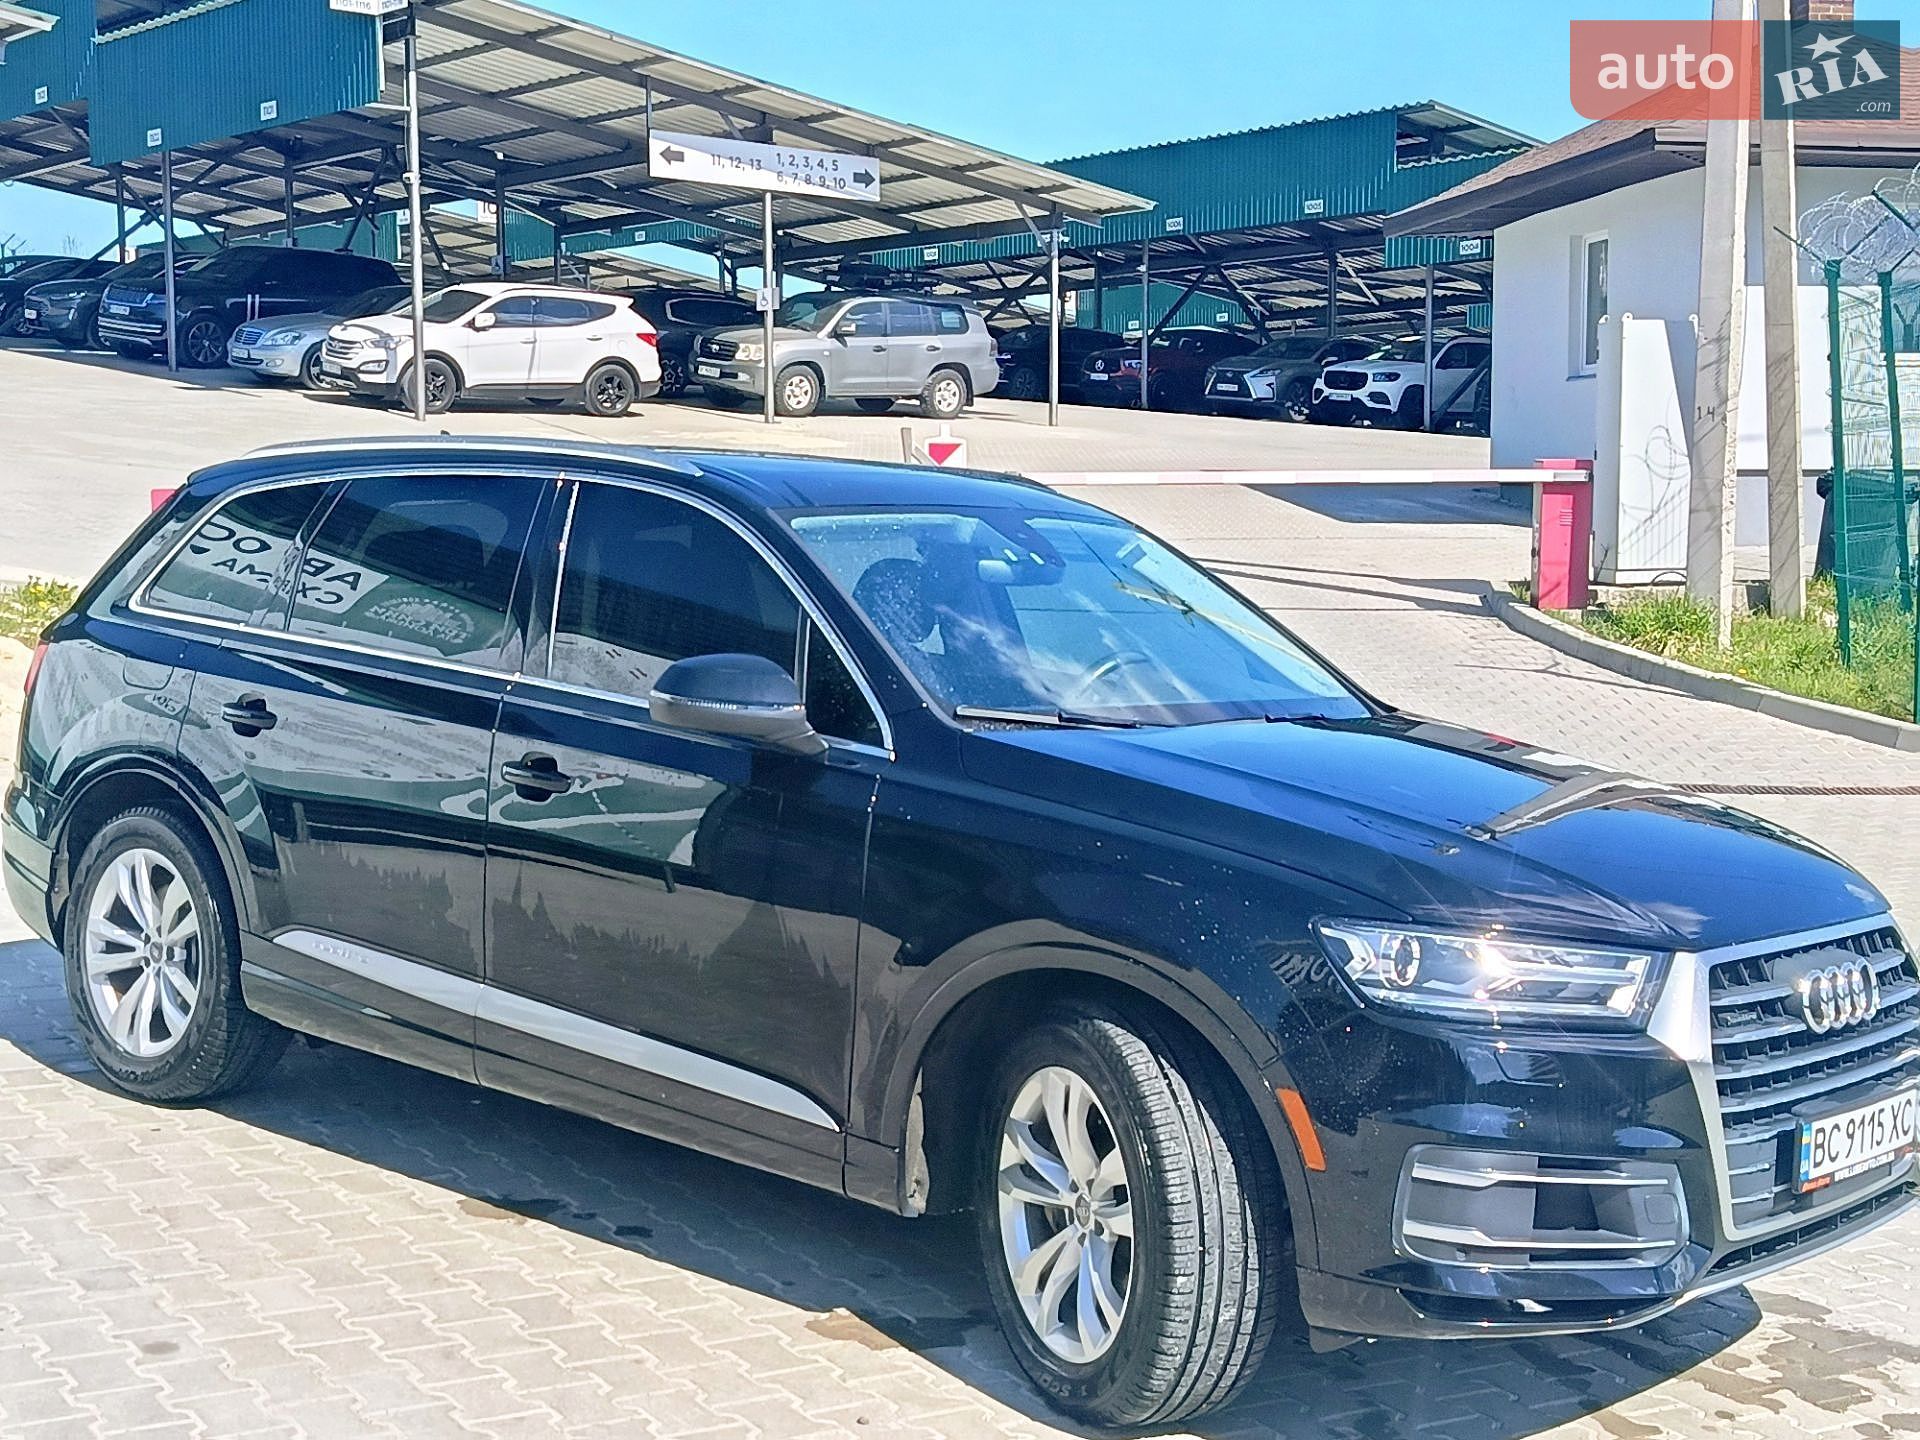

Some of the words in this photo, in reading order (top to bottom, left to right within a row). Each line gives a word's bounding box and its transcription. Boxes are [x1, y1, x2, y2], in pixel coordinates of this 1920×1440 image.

[711, 153, 725, 169] 11,
[729, 156, 745, 171] 12,
[749, 158, 762, 171] 13
[776, 152, 785, 168] 1,
[788, 154, 799, 169] 2,
[802, 156, 814, 171] 3,
[816, 158, 828, 172] 4,
[831, 159, 839, 171] 5
[832, 177, 846, 190] 10
[1812, 1122, 1841, 1169] BC
[1845, 1107, 1885, 1159] 9115
[1888, 1097, 1913, 1144] XC
